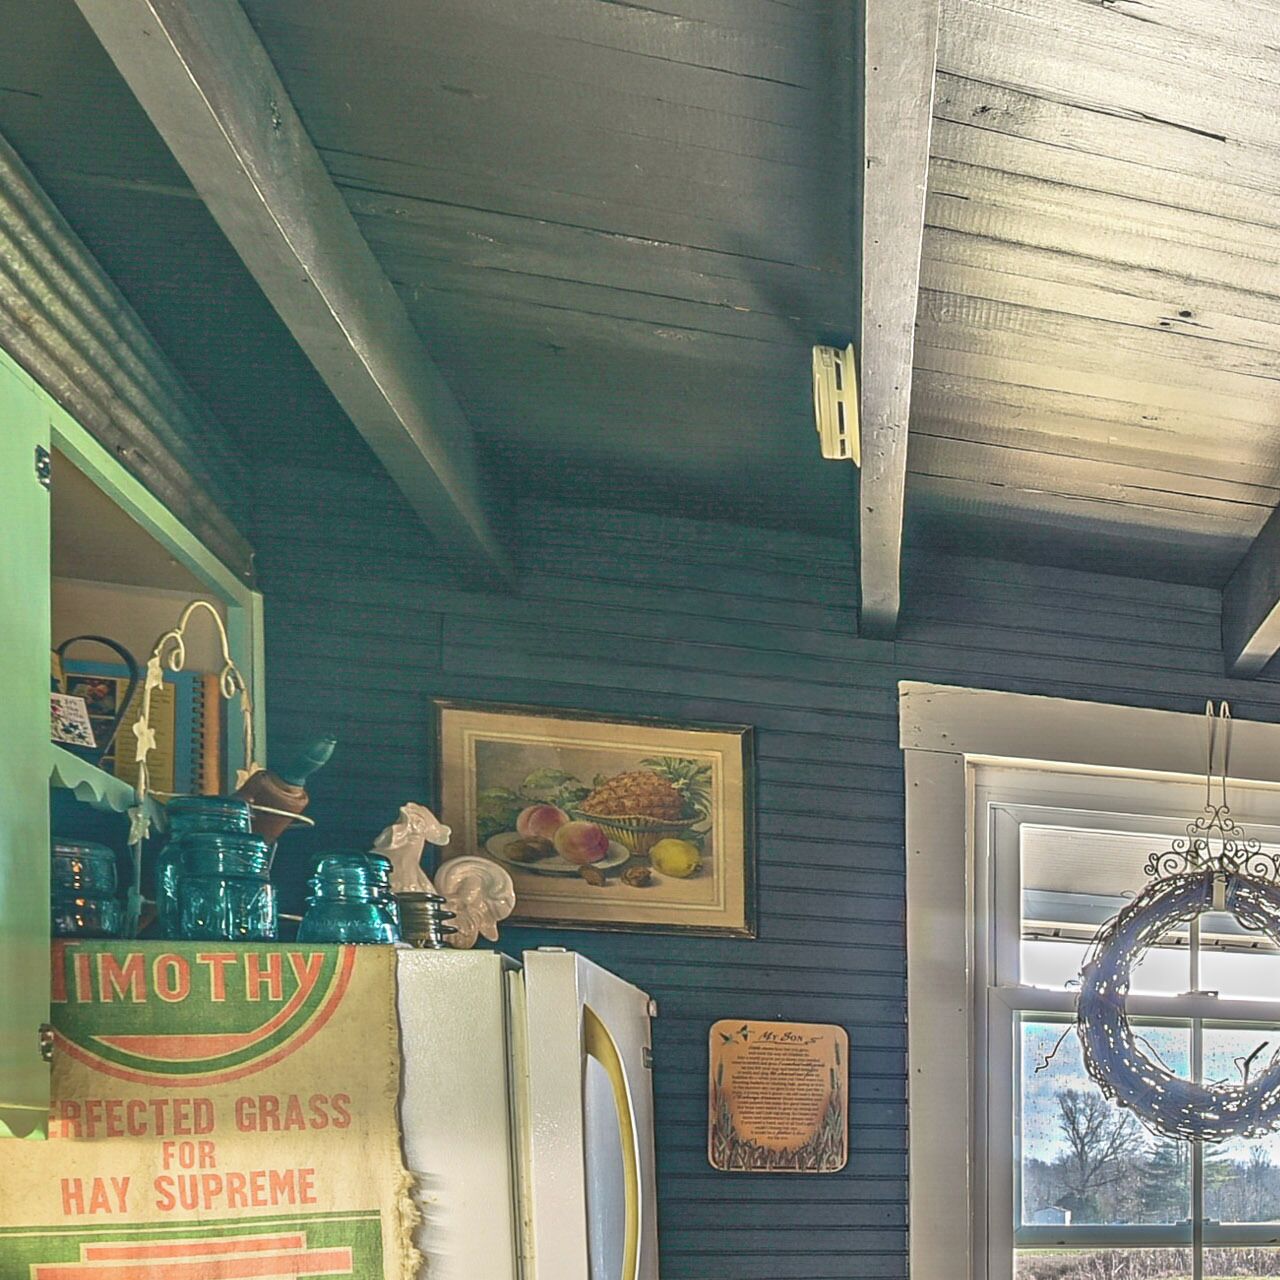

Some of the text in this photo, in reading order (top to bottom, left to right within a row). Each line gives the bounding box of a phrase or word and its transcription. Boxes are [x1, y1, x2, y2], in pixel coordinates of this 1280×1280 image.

[50, 939, 326, 1003] TIMOTHY
[49, 1094, 351, 1139] RFECTED GRASS
[162, 1140, 216, 1170] FOR
[61, 1168, 317, 1215] HAY SUPREME
